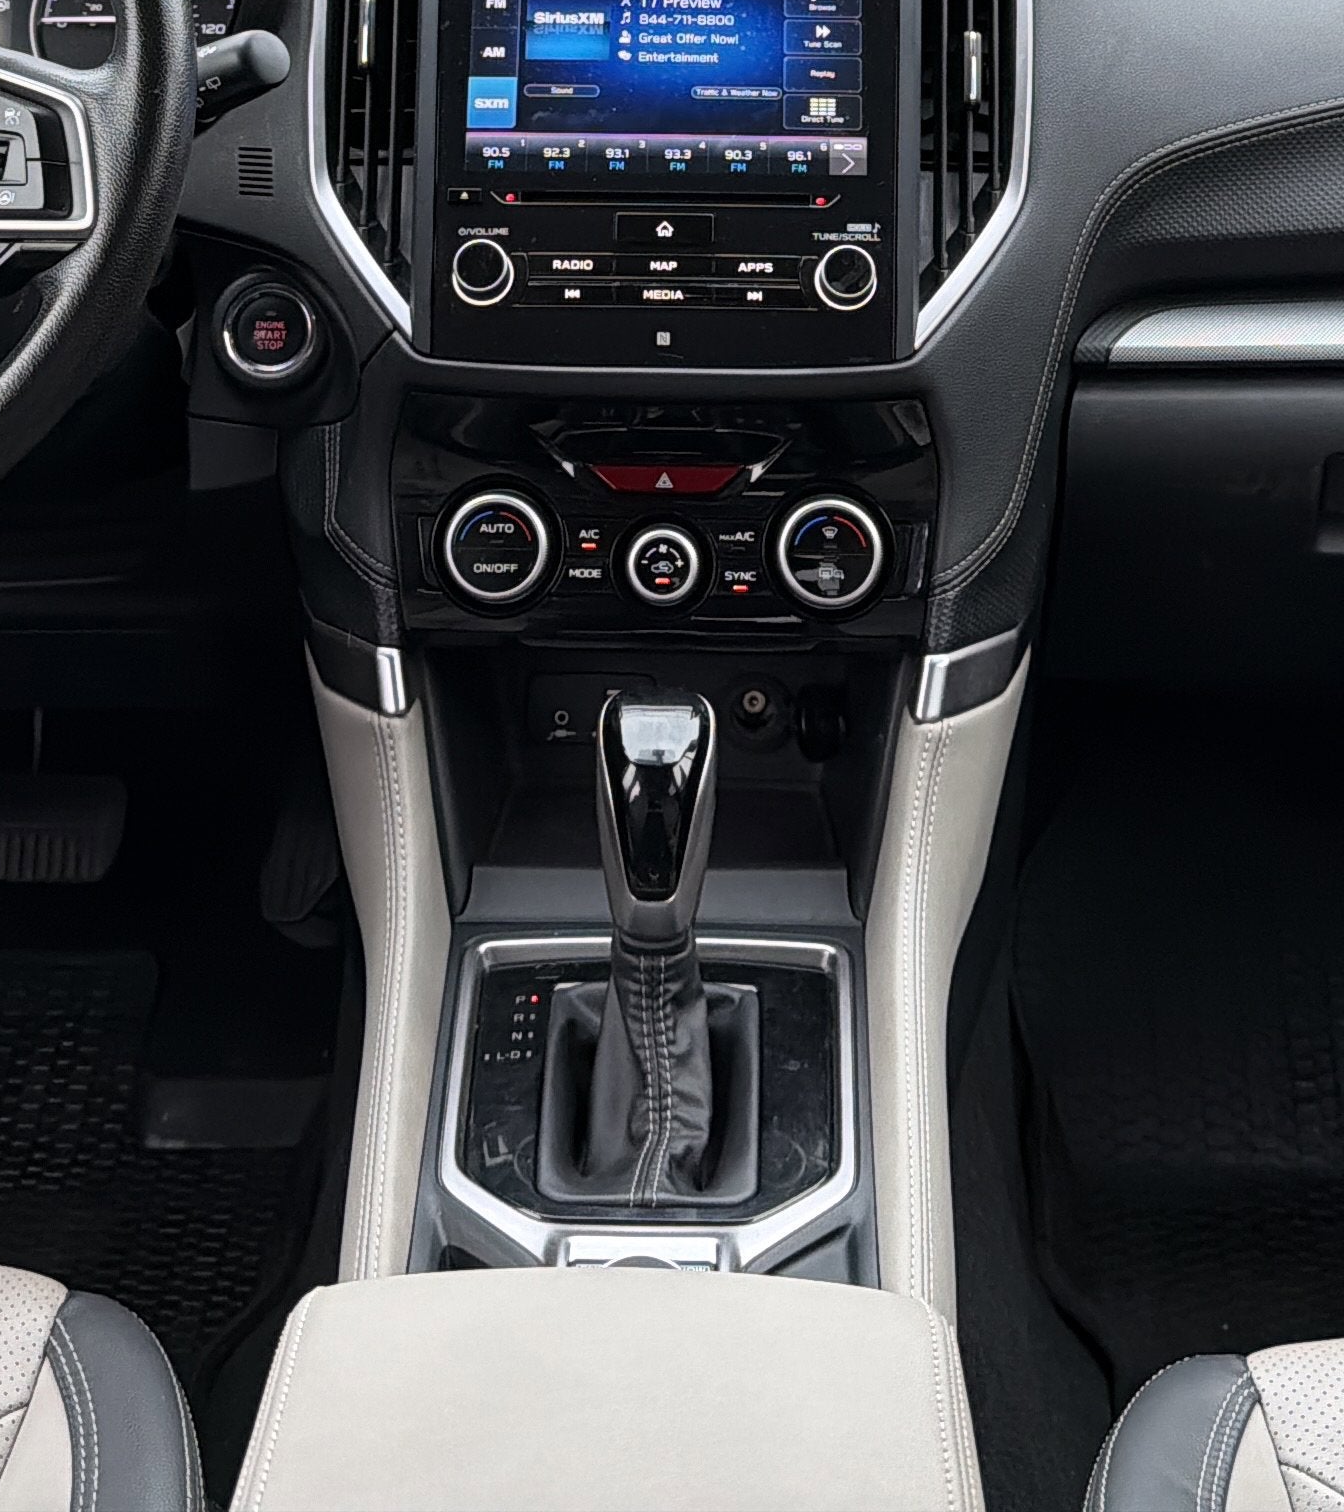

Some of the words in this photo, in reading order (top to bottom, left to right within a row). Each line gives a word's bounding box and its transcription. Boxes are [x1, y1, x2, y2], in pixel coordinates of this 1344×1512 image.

[533, 11, 605, 25] SiriusXM
[638, 13, 735, 26] 844-711-8800
[200, 23, 226, 35] 120
[638, 32, 673, 44] Great
[676, 32, 707, 44] Offer
[710, 33, 740, 45] Now!
[803, 40, 822, 49] Tune
[482, 46, 506, 58] AM
[637, 51, 720, 64] Entertainment
[474, 97, 509, 110] sxm
[800, 115, 825, 124] Direct
[520, 138, 526, 147] 1
[577, 139, 586, 148] 2
[638, 140, 647, 149] 3
[698, 141, 707, 150] 4
[759, 142, 768, 151] 5
[819, 142, 828, 152] 6
[482, 146, 511, 158] 90.5
[542, 147, 571, 158] 92.3
[605, 148, 630, 159] 93.1
[664, 148, 692, 160] 93.3
[724, 149, 753, 161] 90.3
[786, 150, 813, 162] 96.1
[487, 159, 504, 169] FM
[548, 160, 565, 170] FM
[608, 161, 625, 171] FM
[669, 161, 686, 172] FM
[730, 162, 747, 173] FM
[791, 163, 808, 174] FM
[811, 232, 882, 242] TUNE/SCROLL
[551, 259, 594, 272] RADIO
[649, 261, 678, 272] MAP
[737, 262, 774, 274] APPS
[642, 289, 685, 301] MEDIA
[255, 320, 286, 330] ENGINE
[253, 330, 288, 340] START
[256, 341, 284, 351] STOP
[479, 522, 515, 534] AUTO
[578, 528, 601, 540] A/C
[735, 531, 756, 542] A/C
[472, 562, 519, 575] ON/OFF
[568, 568, 603, 580] MODE
[724, 571, 757, 583] SYNC
[515, 995, 526, 1006] P
[513, 1013, 525, 1023] R
[511, 1031, 523, 1041] N
